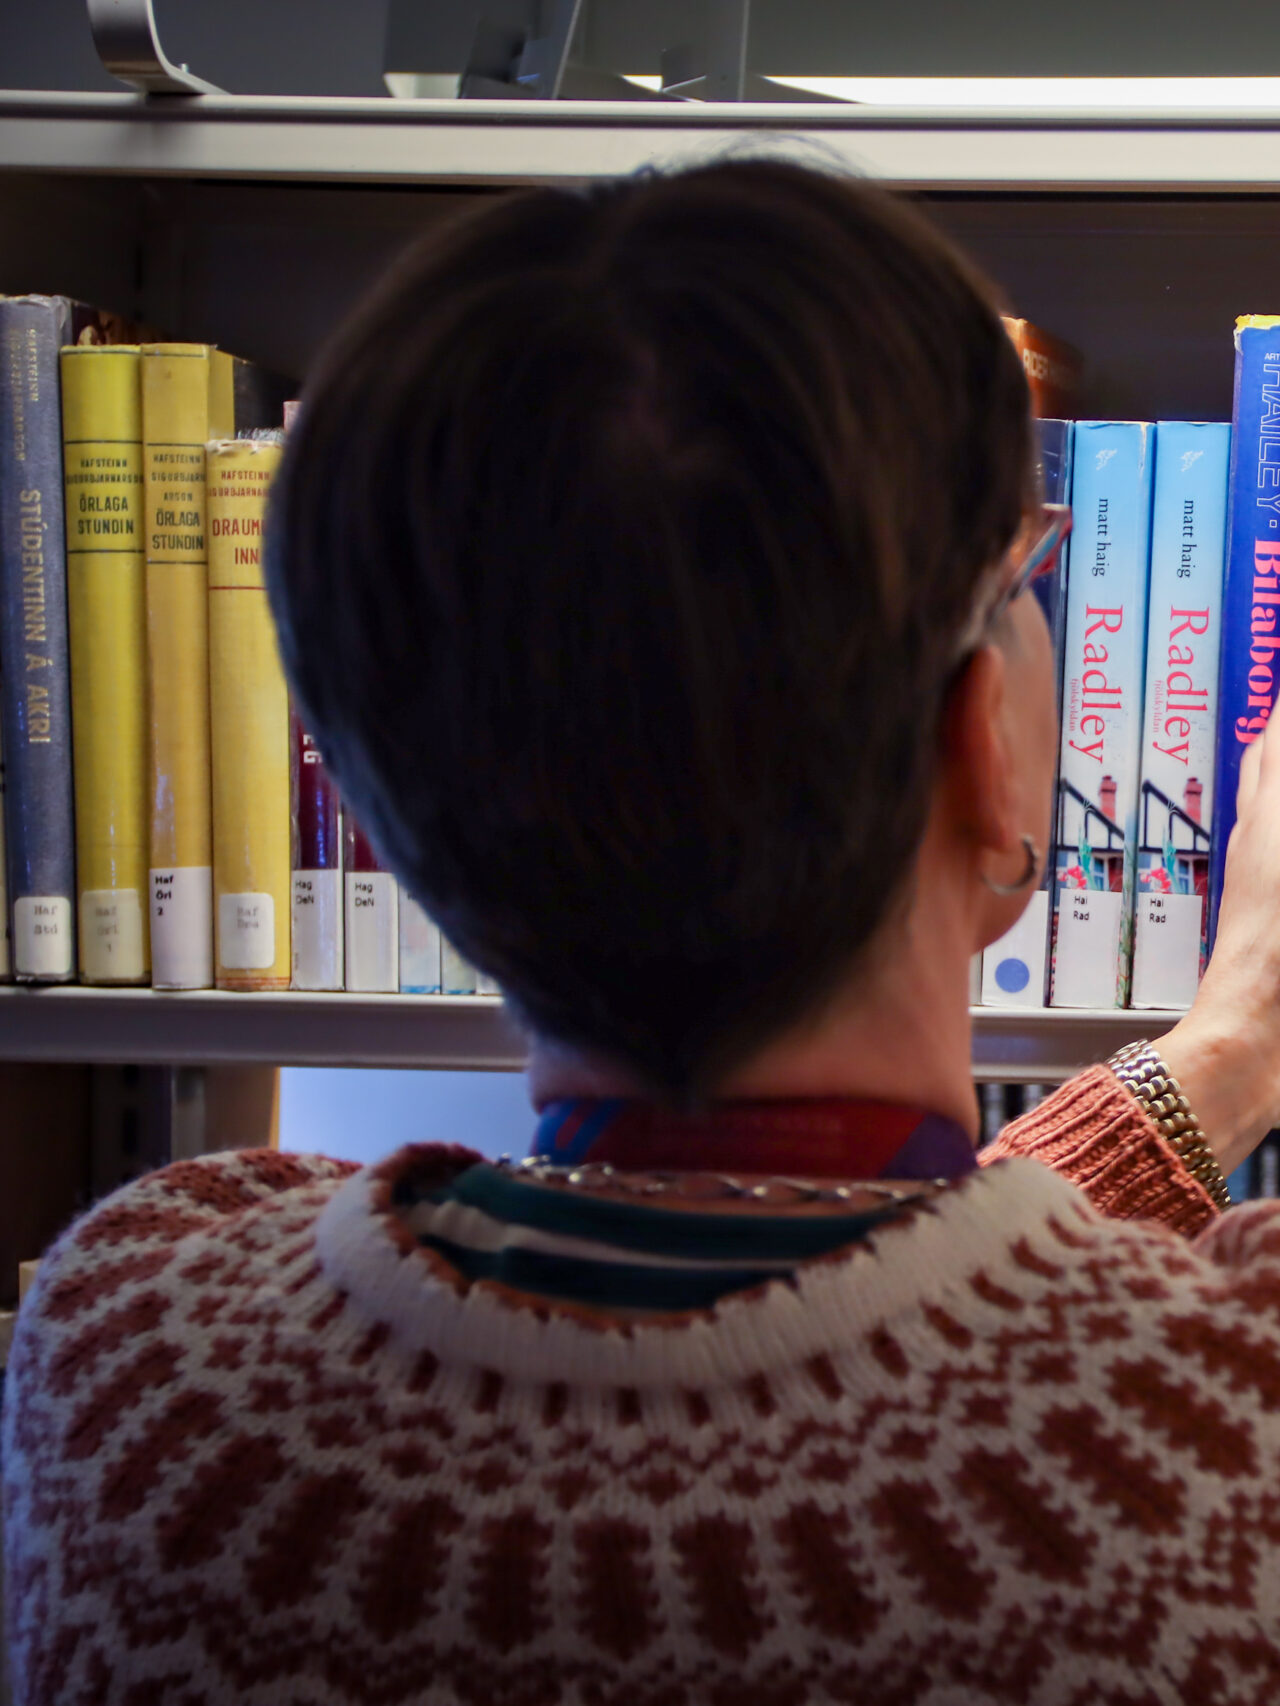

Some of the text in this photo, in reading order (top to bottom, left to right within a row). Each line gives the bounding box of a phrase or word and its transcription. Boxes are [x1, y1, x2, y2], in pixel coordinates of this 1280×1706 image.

[79, 494, 129, 513] ÖRLAGA
[155, 508, 200, 527] ÖRLAGA
[77, 518, 135, 535] STUNDIN
[151, 534, 205, 550] STUNDIN
[1091, 497, 1112, 577] matt haig
[1176, 499, 1198, 579] matt haig
[234, 547, 260, 565] INN
[20, 489, 54, 744] STÚDENTINN Á AKRI
[1068, 602, 1125, 764] Radley
[1152, 604, 1211, 766] Radley
[154, 875, 174, 885] Haf
[295, 880, 312, 891] Hag
[354, 882, 373, 894] Hag
[155, 890, 172, 900] Örl
[295, 895, 315, 905] DeN
[1074, 895, 1088, 905] Hai
[354, 897, 375, 907] DeN
[1150, 898, 1164, 908] Hai
[157, 907, 164, 916] 2
[1073, 910, 1090, 921] Rad
[1150, 913, 1166, 924] Rad
